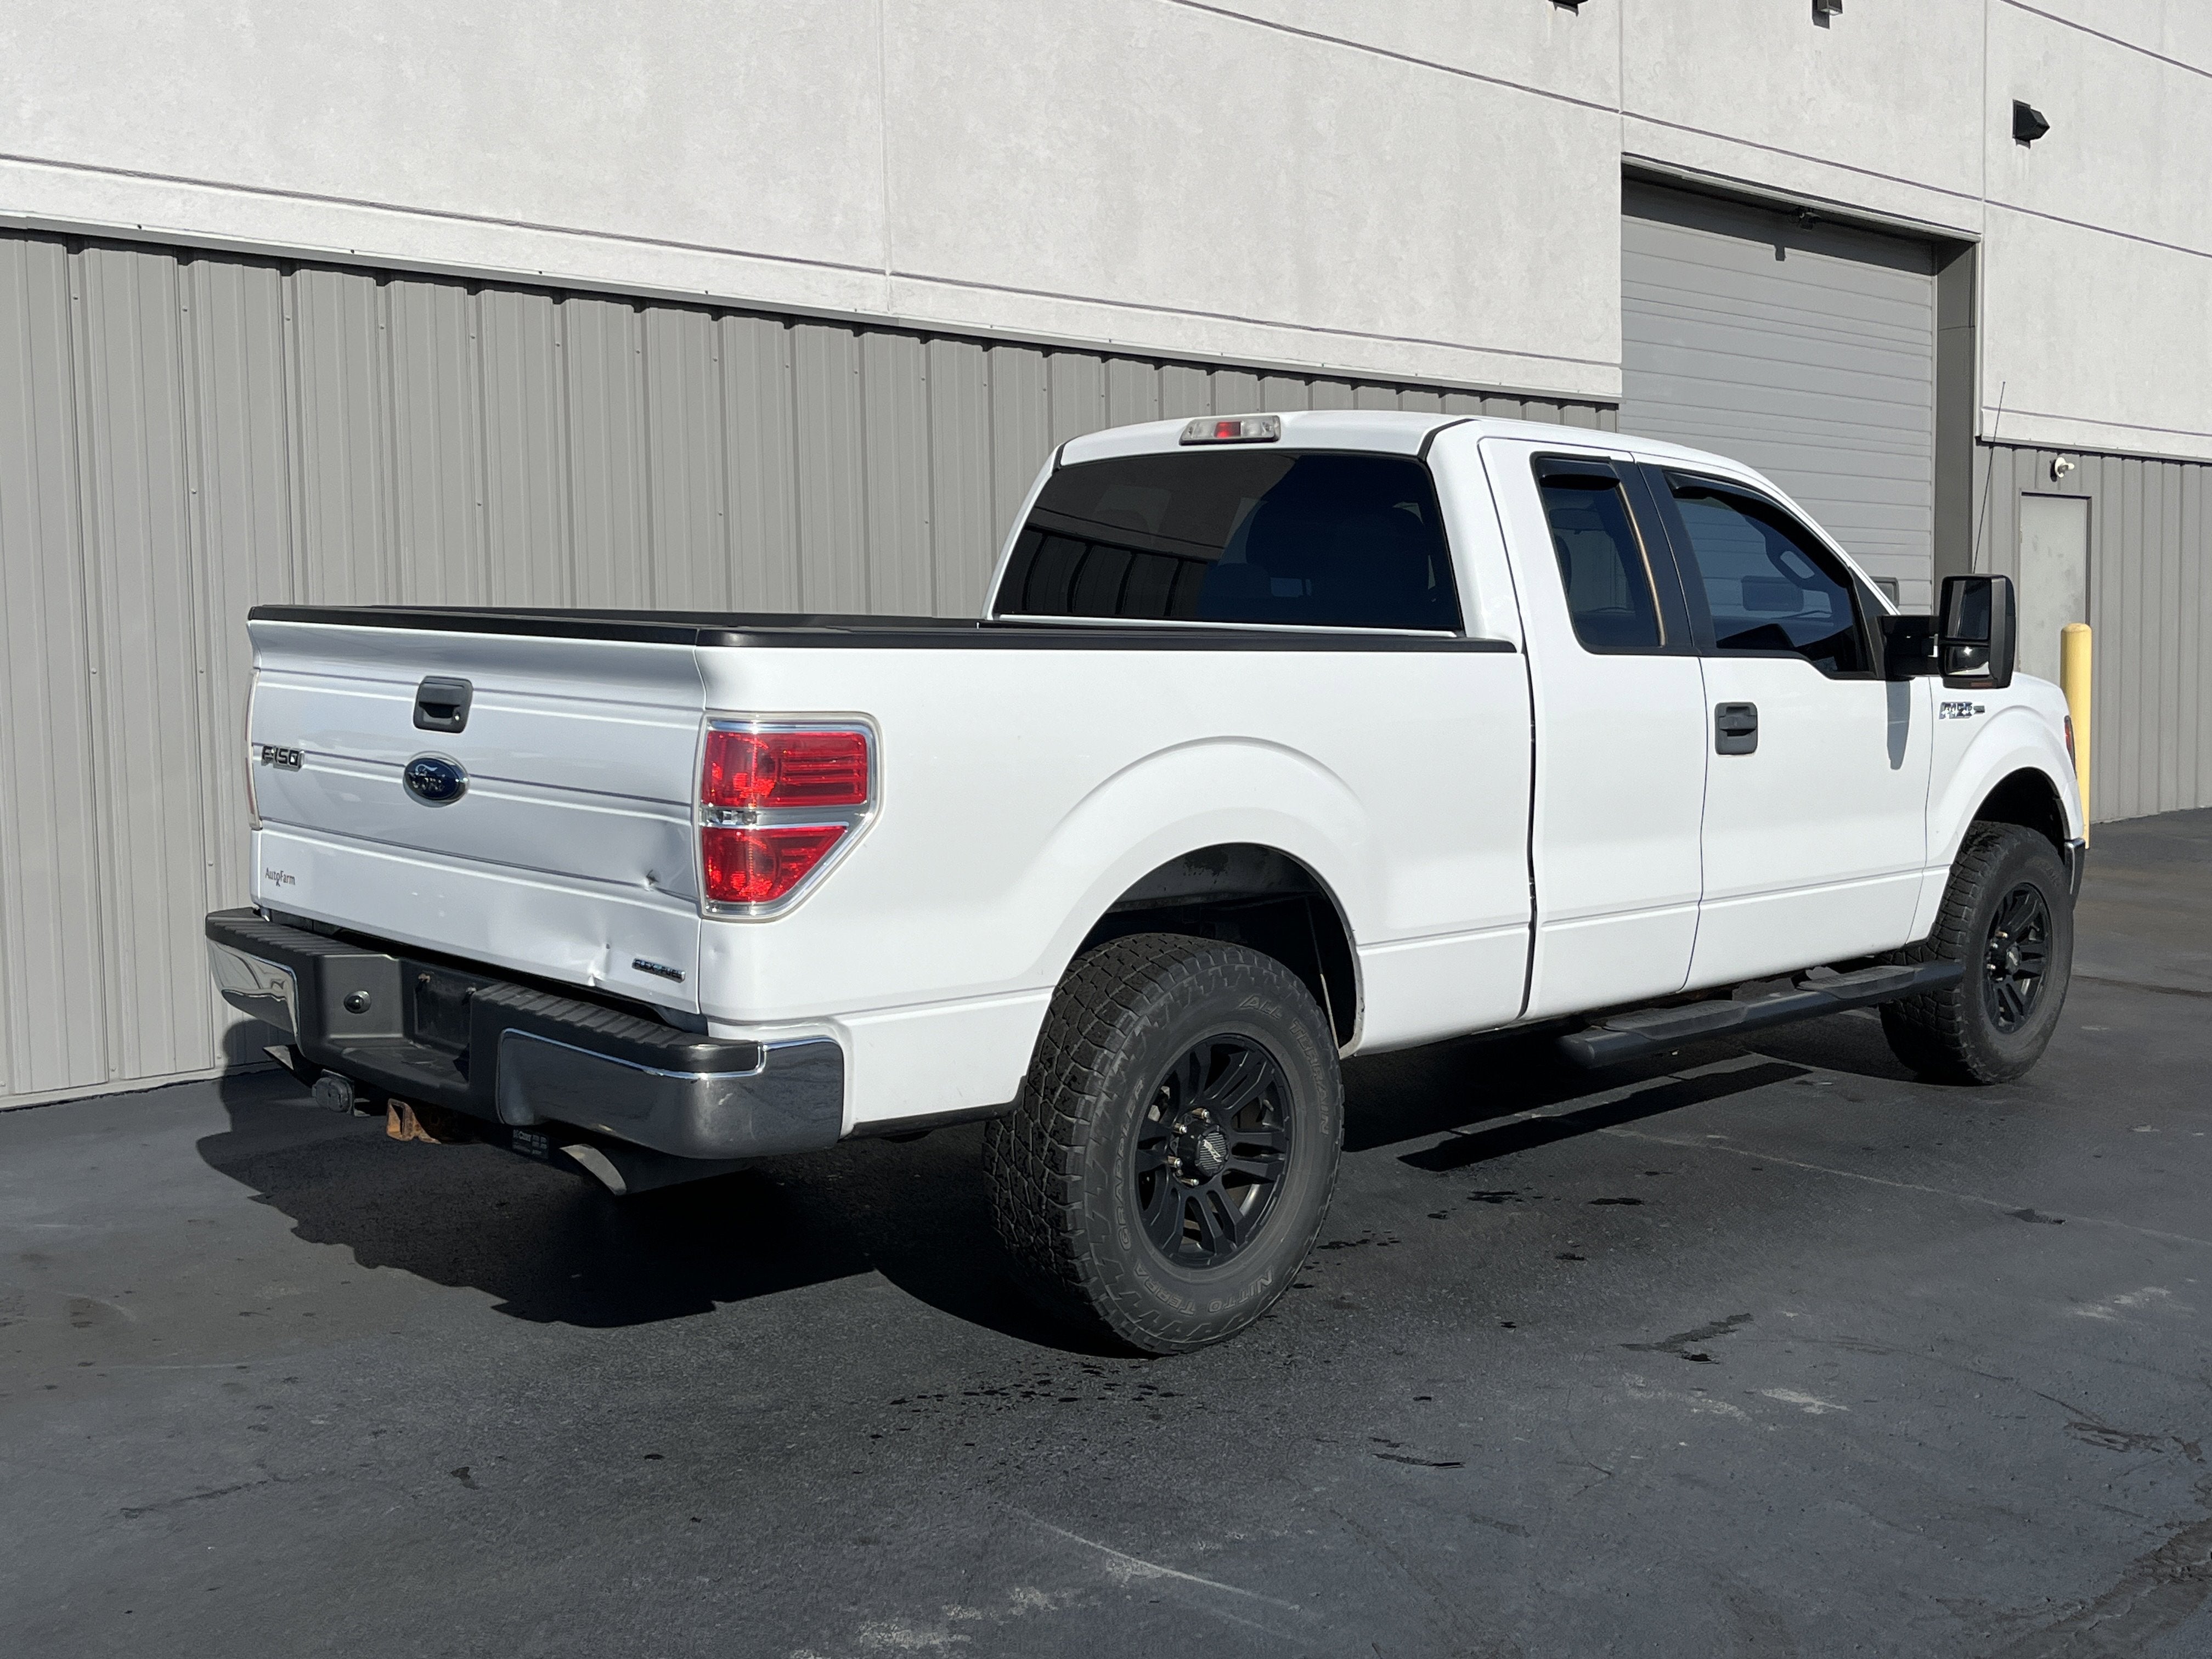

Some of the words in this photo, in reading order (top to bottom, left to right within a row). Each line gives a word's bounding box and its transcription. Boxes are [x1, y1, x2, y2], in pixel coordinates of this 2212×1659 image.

[265, 867, 296, 887] AutoFarm
[635, 958, 655, 972] FLEX
[661, 966, 682, 979] FUEL
[1238, 994, 1283, 1021] ALL
[1289, 1017, 1330, 1135] TERRAIN
[1115, 1077, 1144, 1251] GRAPPLER
[1133, 1259, 1196, 1316] TERRA
[1207, 1265, 1274, 1313] NITTO
